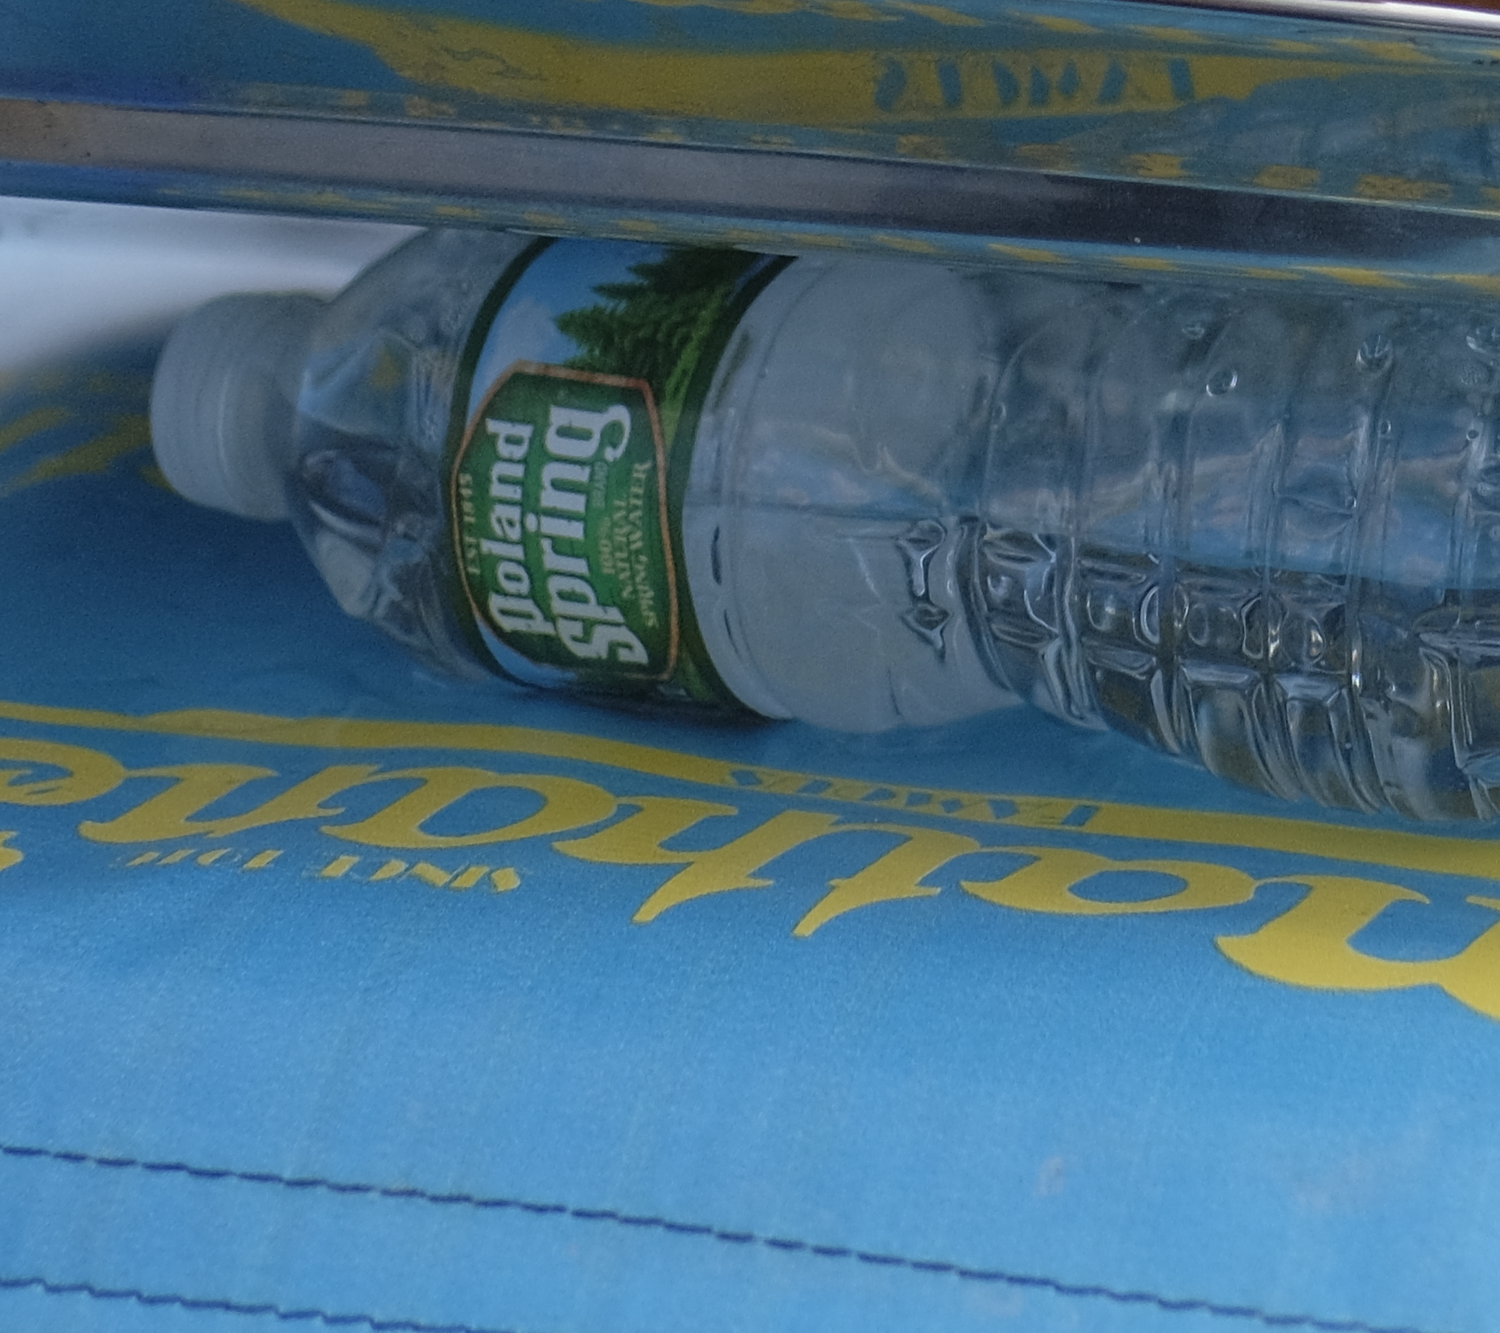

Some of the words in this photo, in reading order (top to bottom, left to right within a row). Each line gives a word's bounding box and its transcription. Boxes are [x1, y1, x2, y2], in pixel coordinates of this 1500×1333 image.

[481, 418, 556, 634] Poland
[526, 404, 649, 664] Spring
[612, 499, 634, 600] NATURAL
